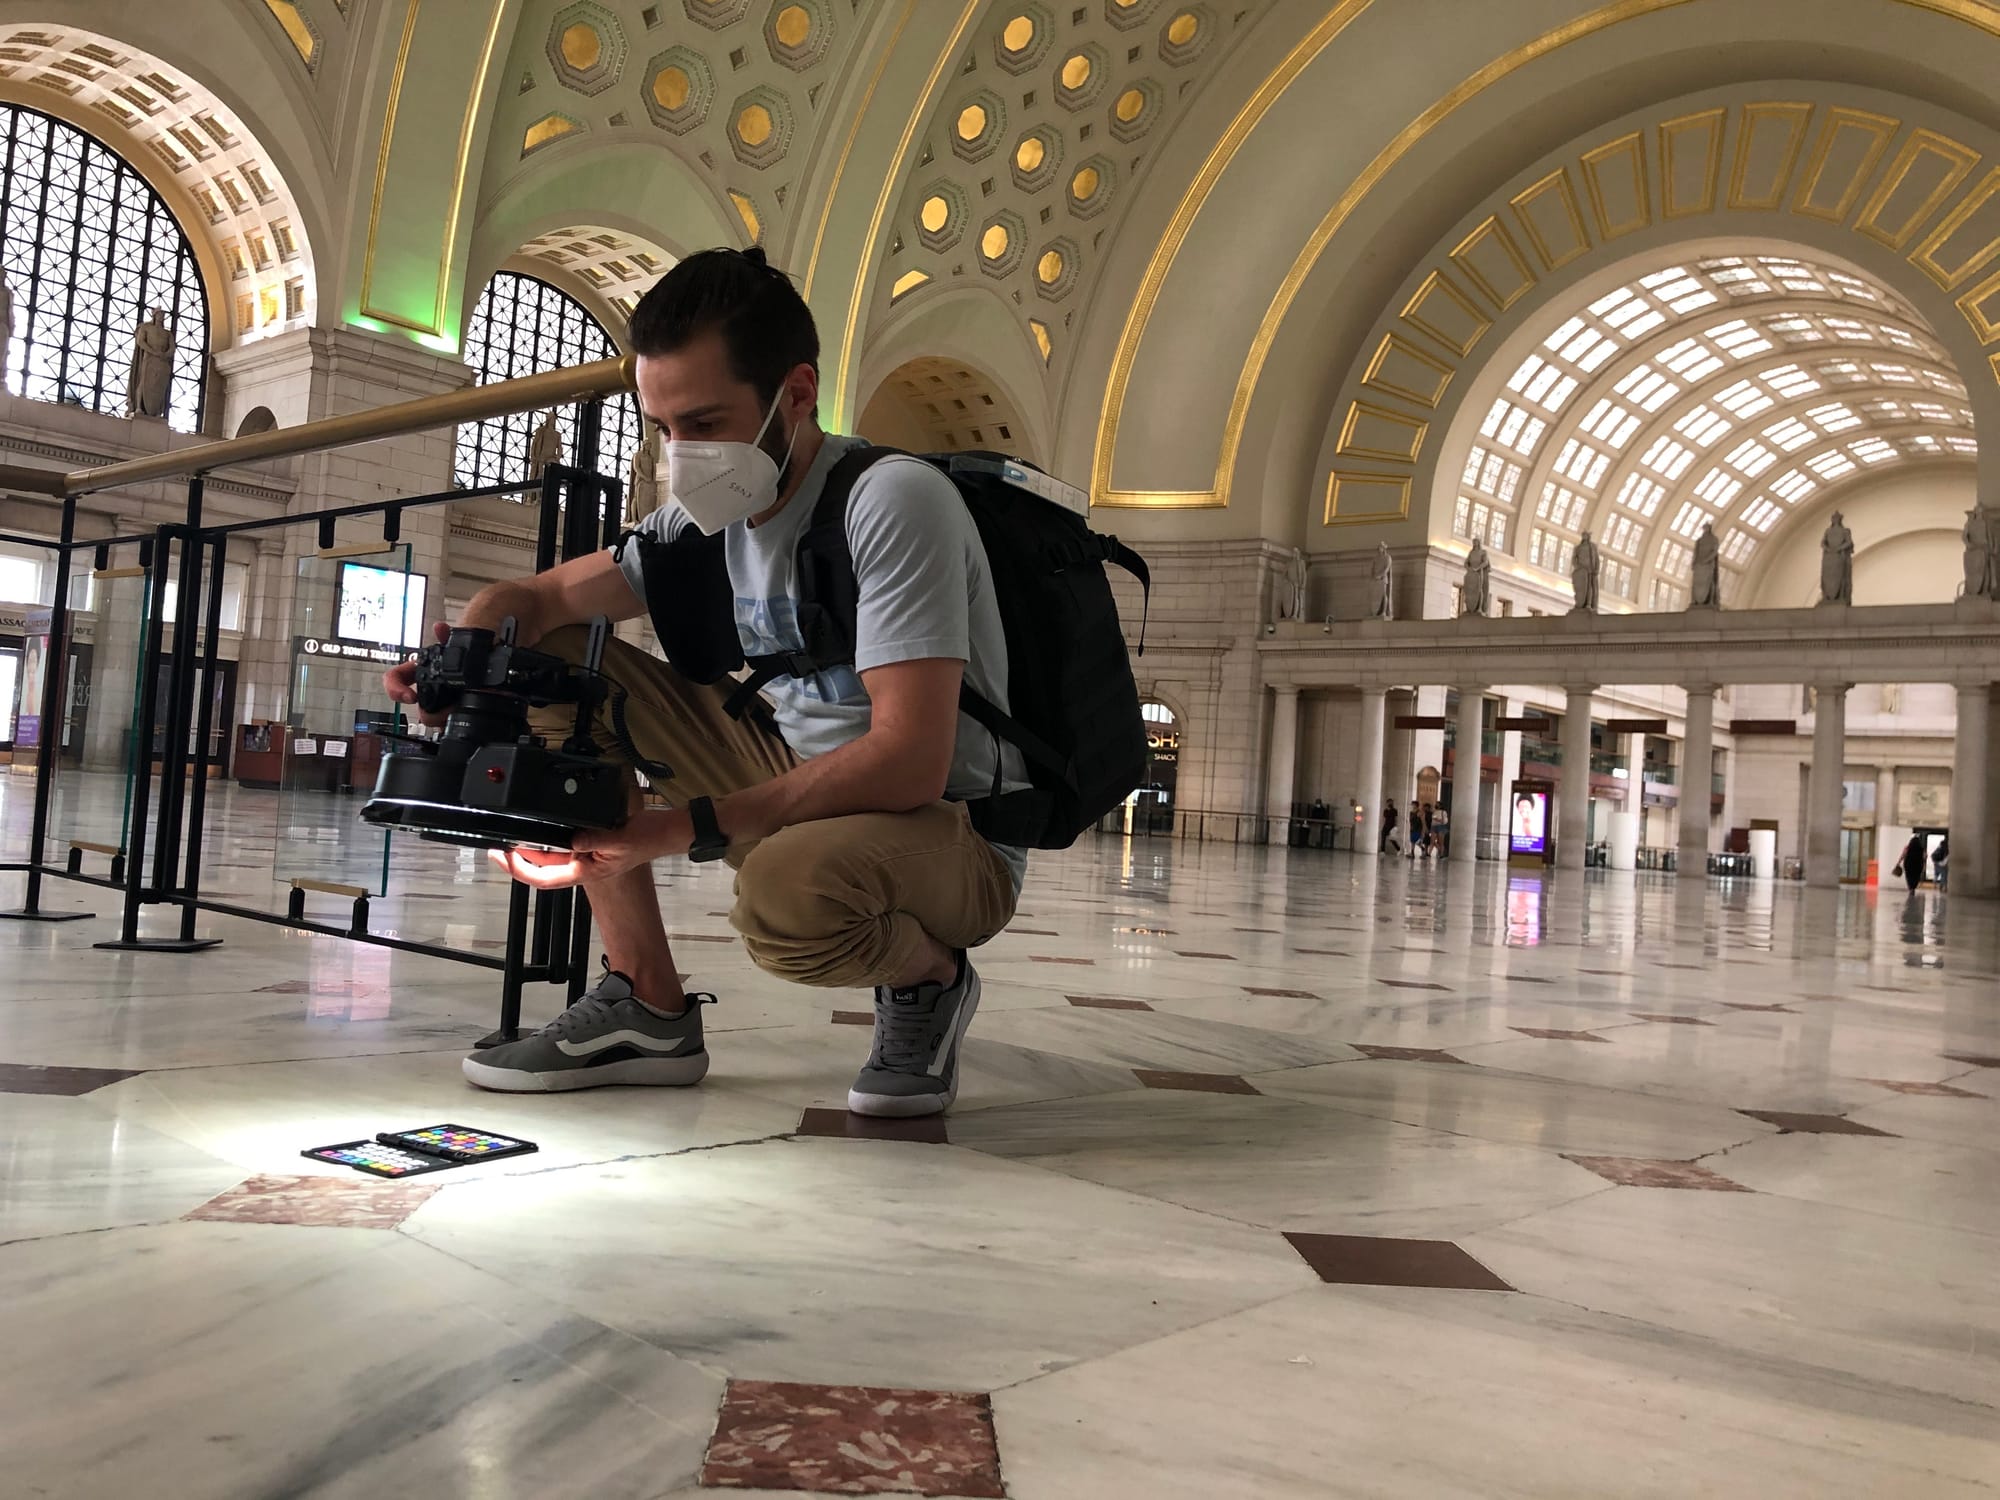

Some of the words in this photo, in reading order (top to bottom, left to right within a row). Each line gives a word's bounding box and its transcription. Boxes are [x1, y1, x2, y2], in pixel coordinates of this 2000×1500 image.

[321, 643, 341, 654] OLD
[342, 645, 369, 658] TOWN
[370, 649, 406, 662] TROLLE
[1147, 729, 1179, 748] SH
